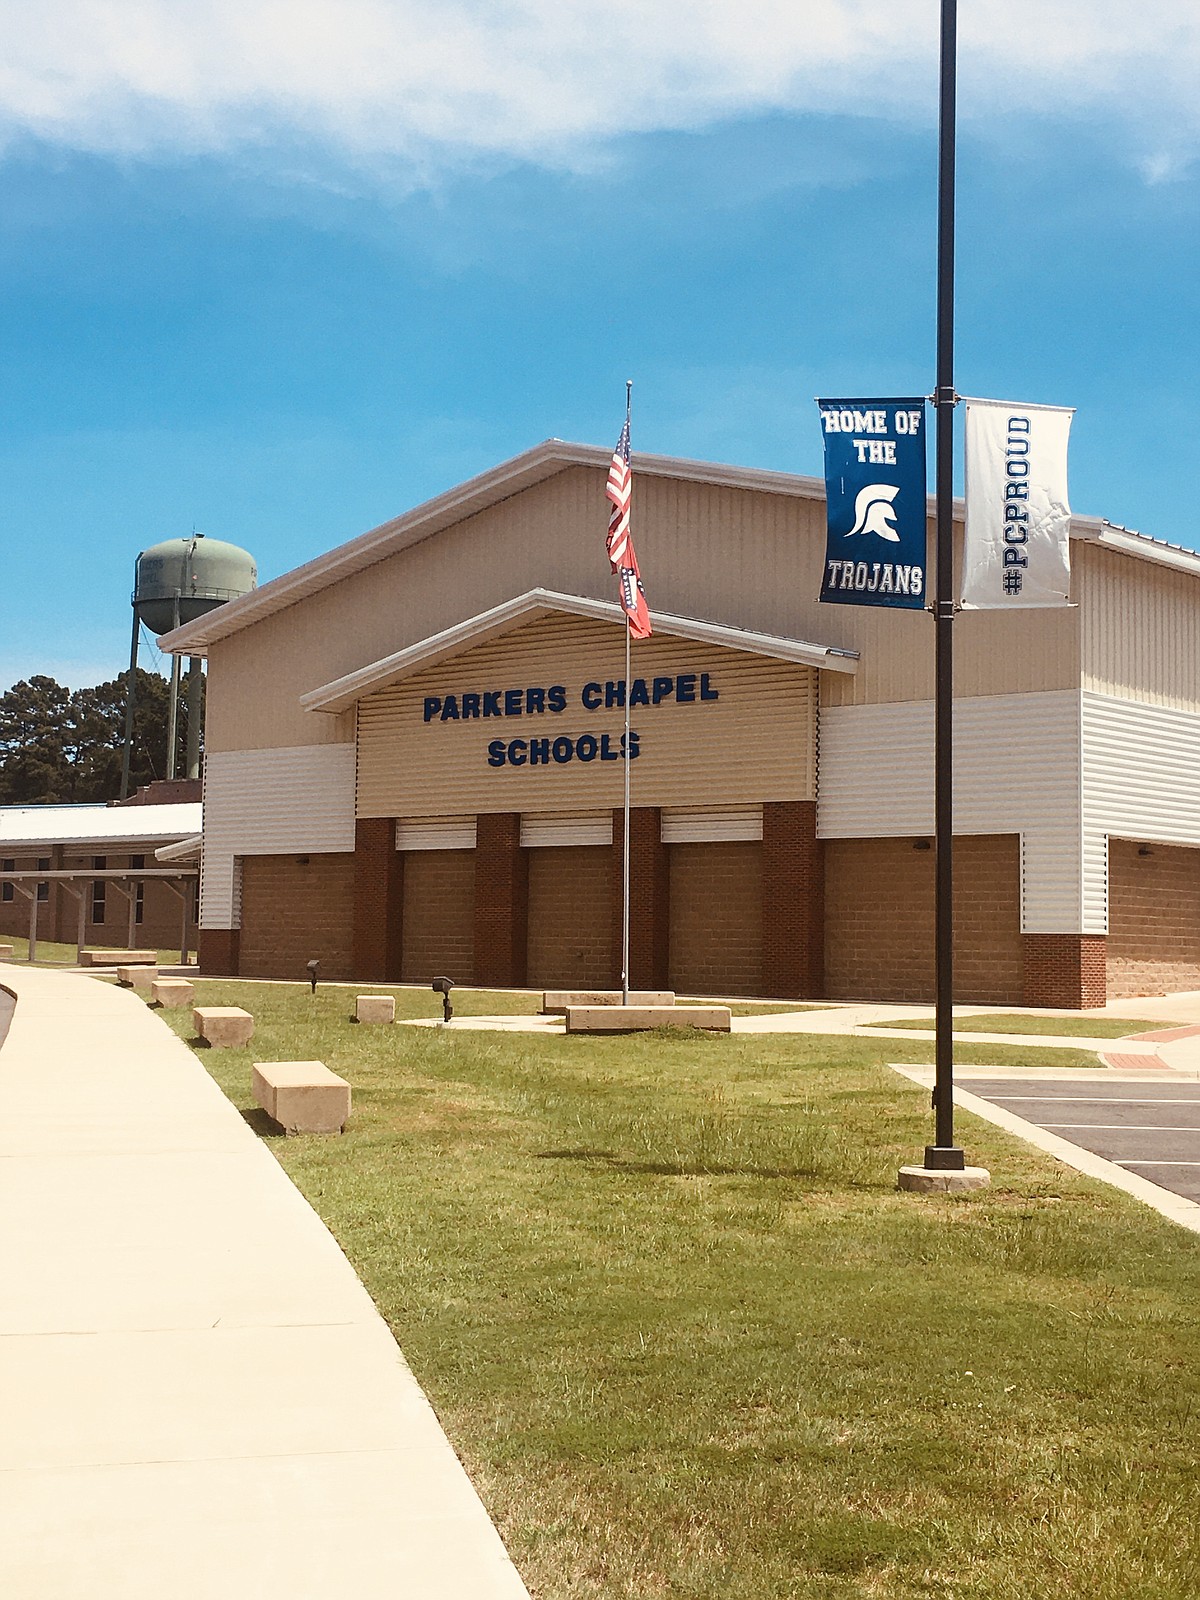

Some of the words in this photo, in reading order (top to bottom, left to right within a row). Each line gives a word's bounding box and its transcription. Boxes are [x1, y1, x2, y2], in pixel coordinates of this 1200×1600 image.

[821, 410, 887, 434] HOME
[895, 411, 922, 435] OF
[853, 439, 897, 465] THE
[1002, 415, 1032, 596] #PCPROUD
[828, 560, 923, 595] TROJANS
[424, 685, 567, 722] PARKERS
[581, 673, 719, 710] CHAPEL
[487, 731, 641, 767] SCHOOLS
